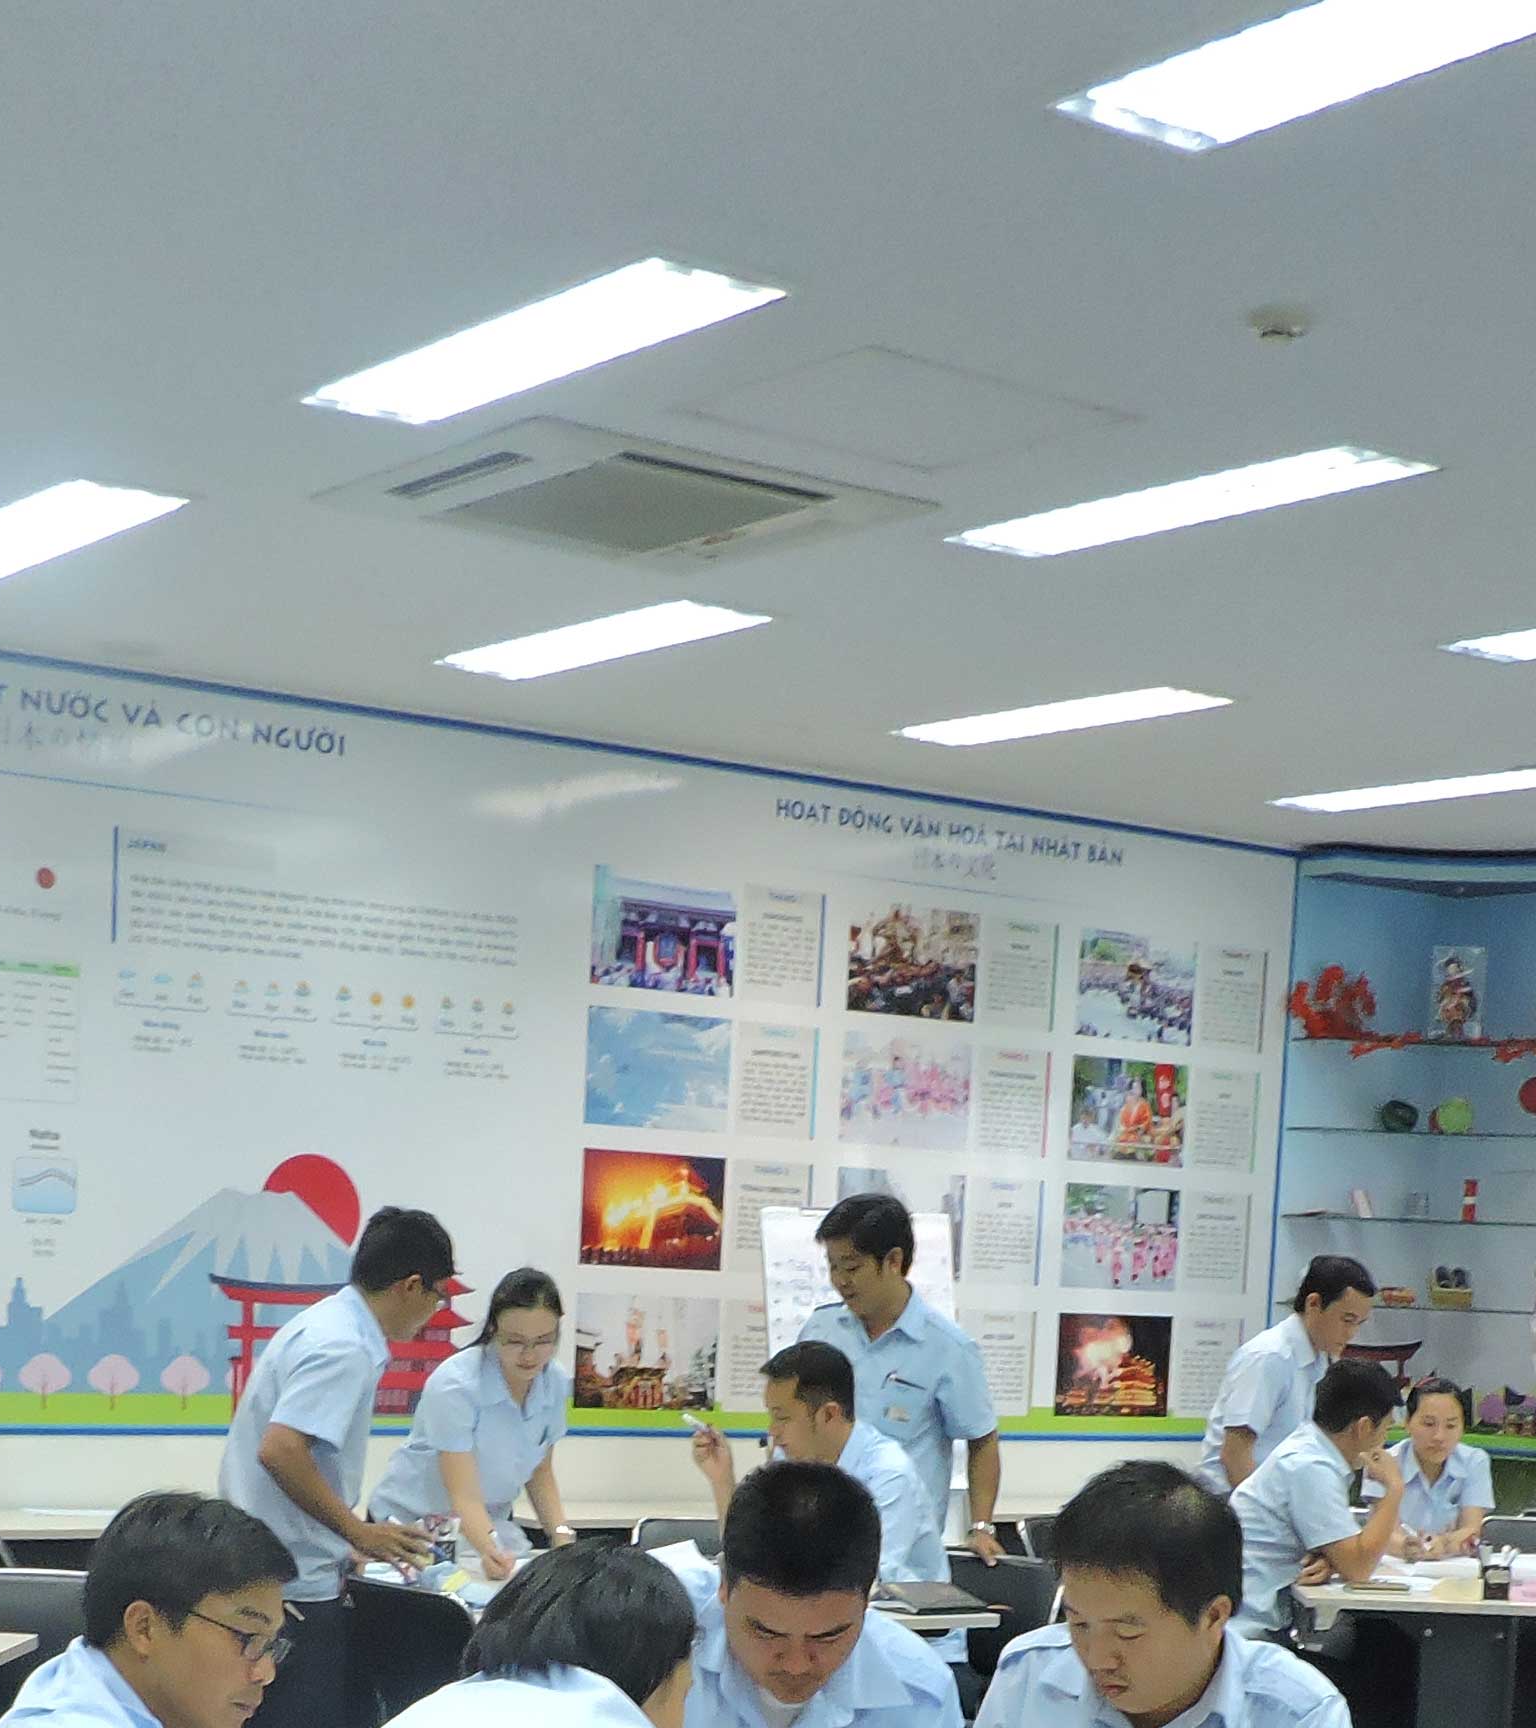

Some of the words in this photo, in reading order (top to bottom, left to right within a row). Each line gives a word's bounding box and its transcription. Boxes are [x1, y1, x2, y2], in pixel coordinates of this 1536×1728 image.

[21, 686, 109, 723] NƯỚC
[176, 711, 240, 741] CON
[251, 724, 346, 757] NGƯỜI
